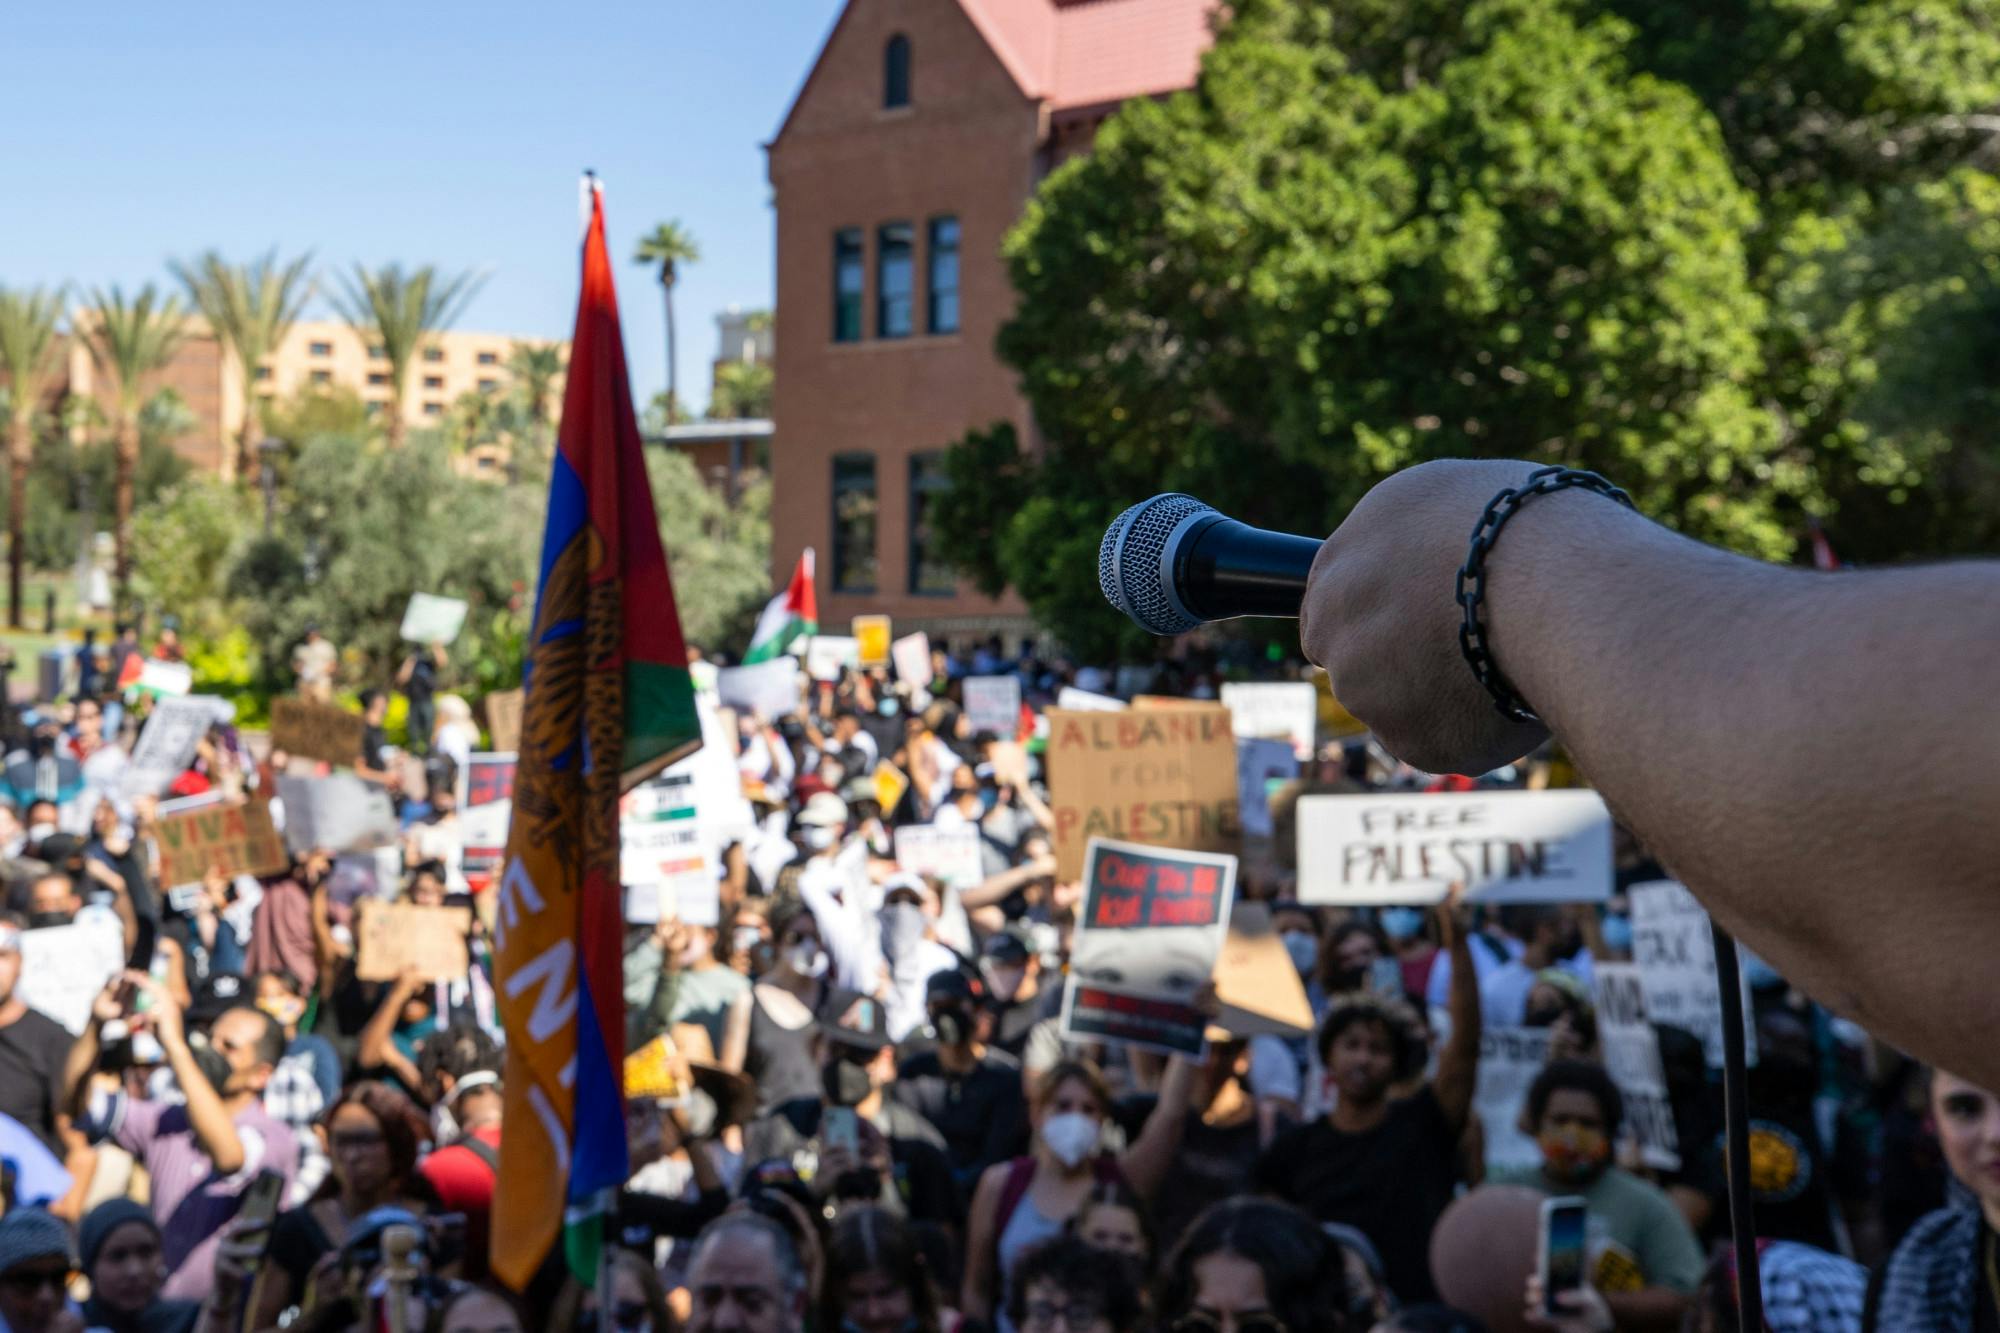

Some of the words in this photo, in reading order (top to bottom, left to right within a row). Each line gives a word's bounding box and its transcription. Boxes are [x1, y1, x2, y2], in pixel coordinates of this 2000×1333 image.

[1060, 714, 1234, 750] ALBANIA
[1110, 758, 1191, 786] FOR
[161, 807, 247, 848] VIVA
[1054, 803, 1241, 845] PALESTINE
[1361, 803, 1487, 835] FREE
[1341, 836, 1576, 885] PALESTINE
